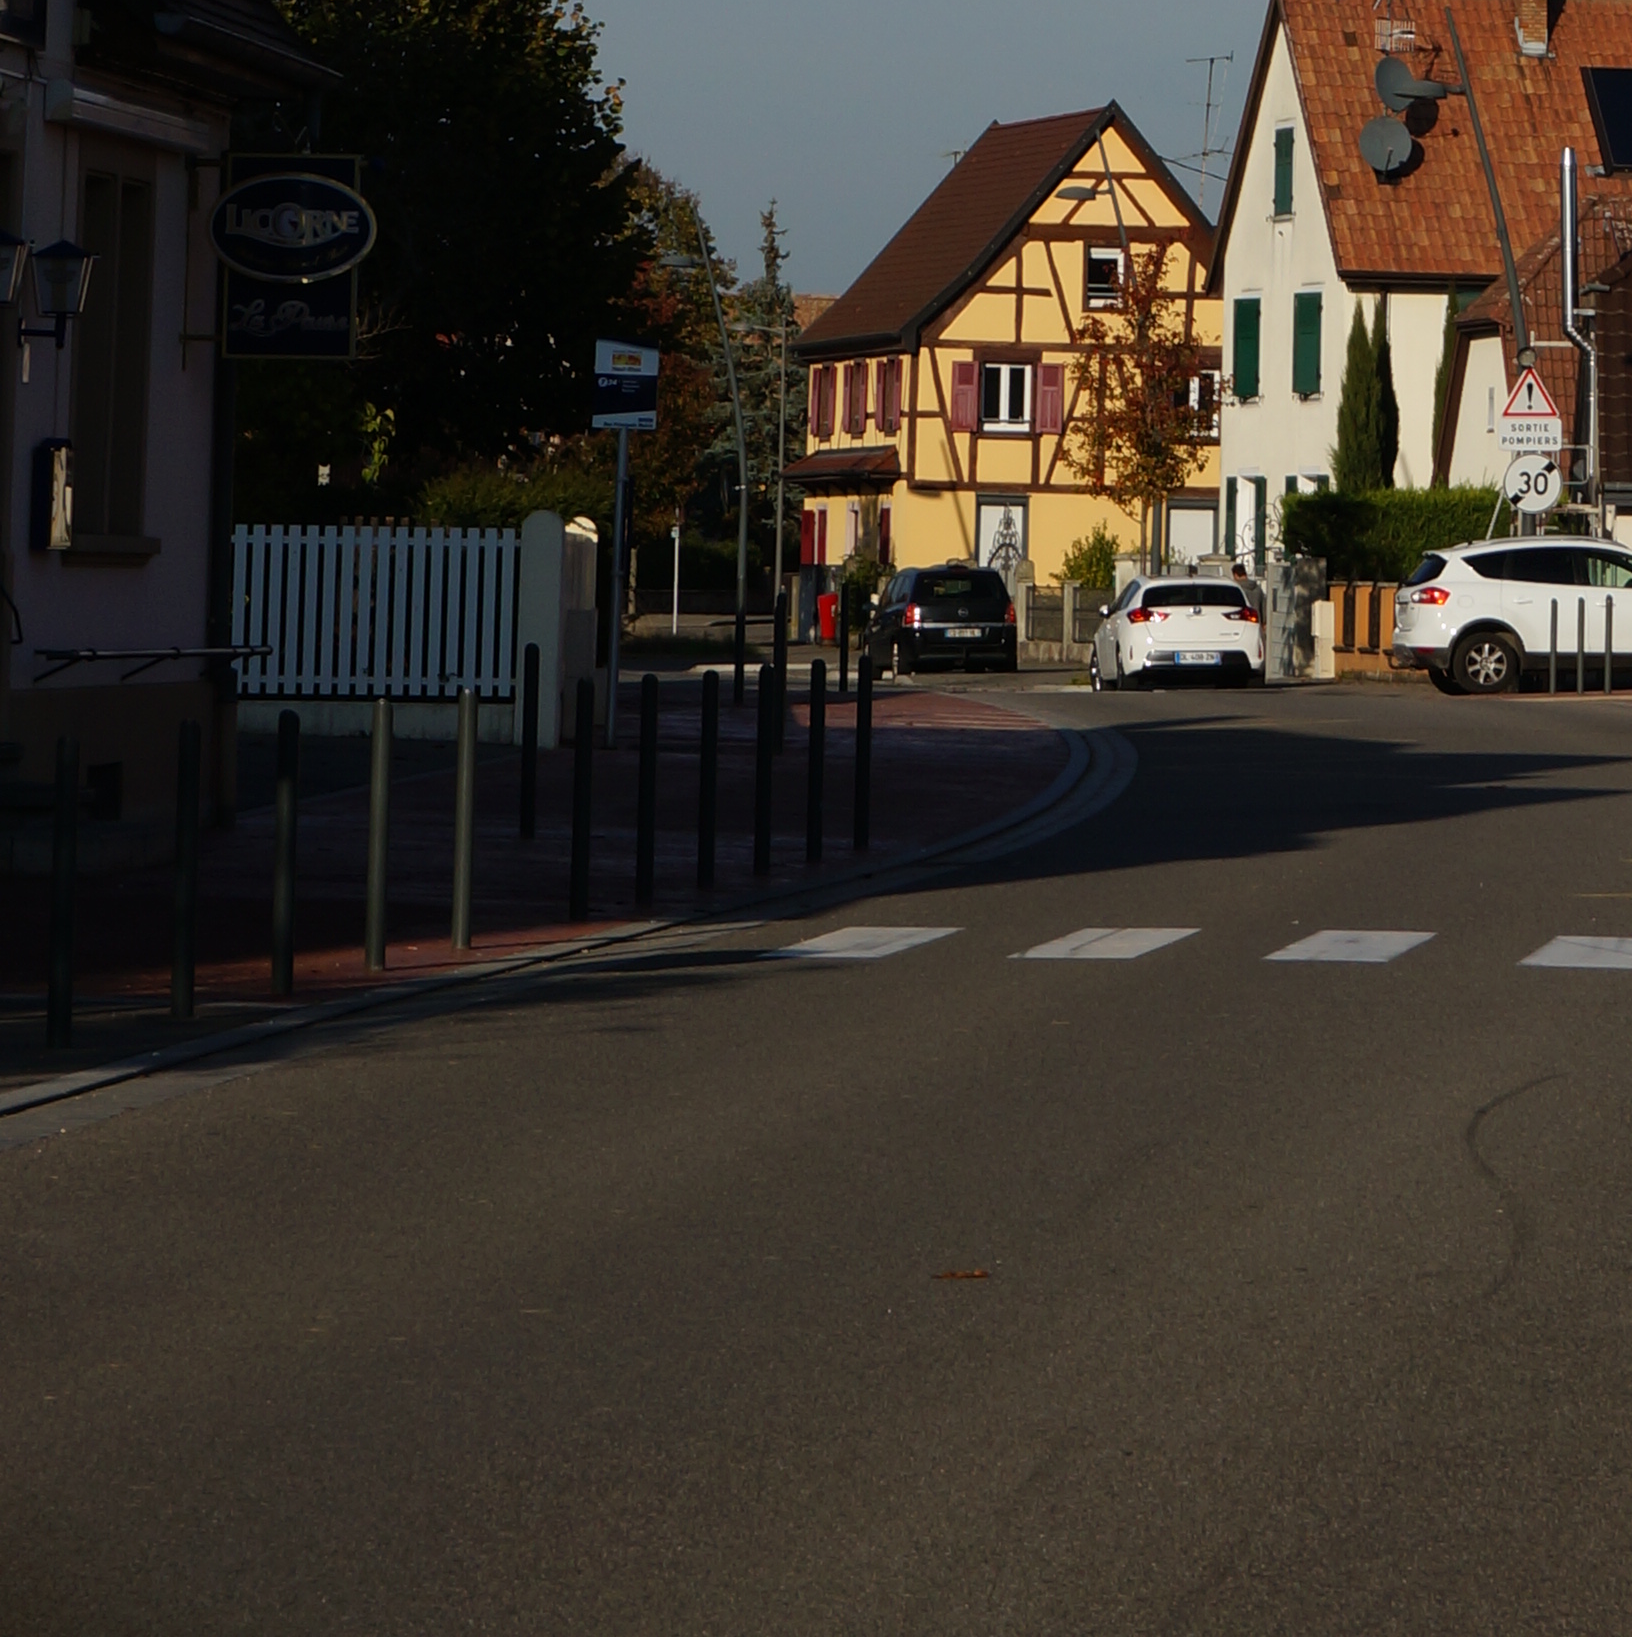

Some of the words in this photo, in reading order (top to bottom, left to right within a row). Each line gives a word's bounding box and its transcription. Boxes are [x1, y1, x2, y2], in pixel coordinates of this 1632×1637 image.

[225, 202, 359, 247] LICORNE
[1511, 423, 1549, 432] SORTIE
[1502, 436, 1559, 445] POMPIERS
[1518, 471, 1549, 495] 30
